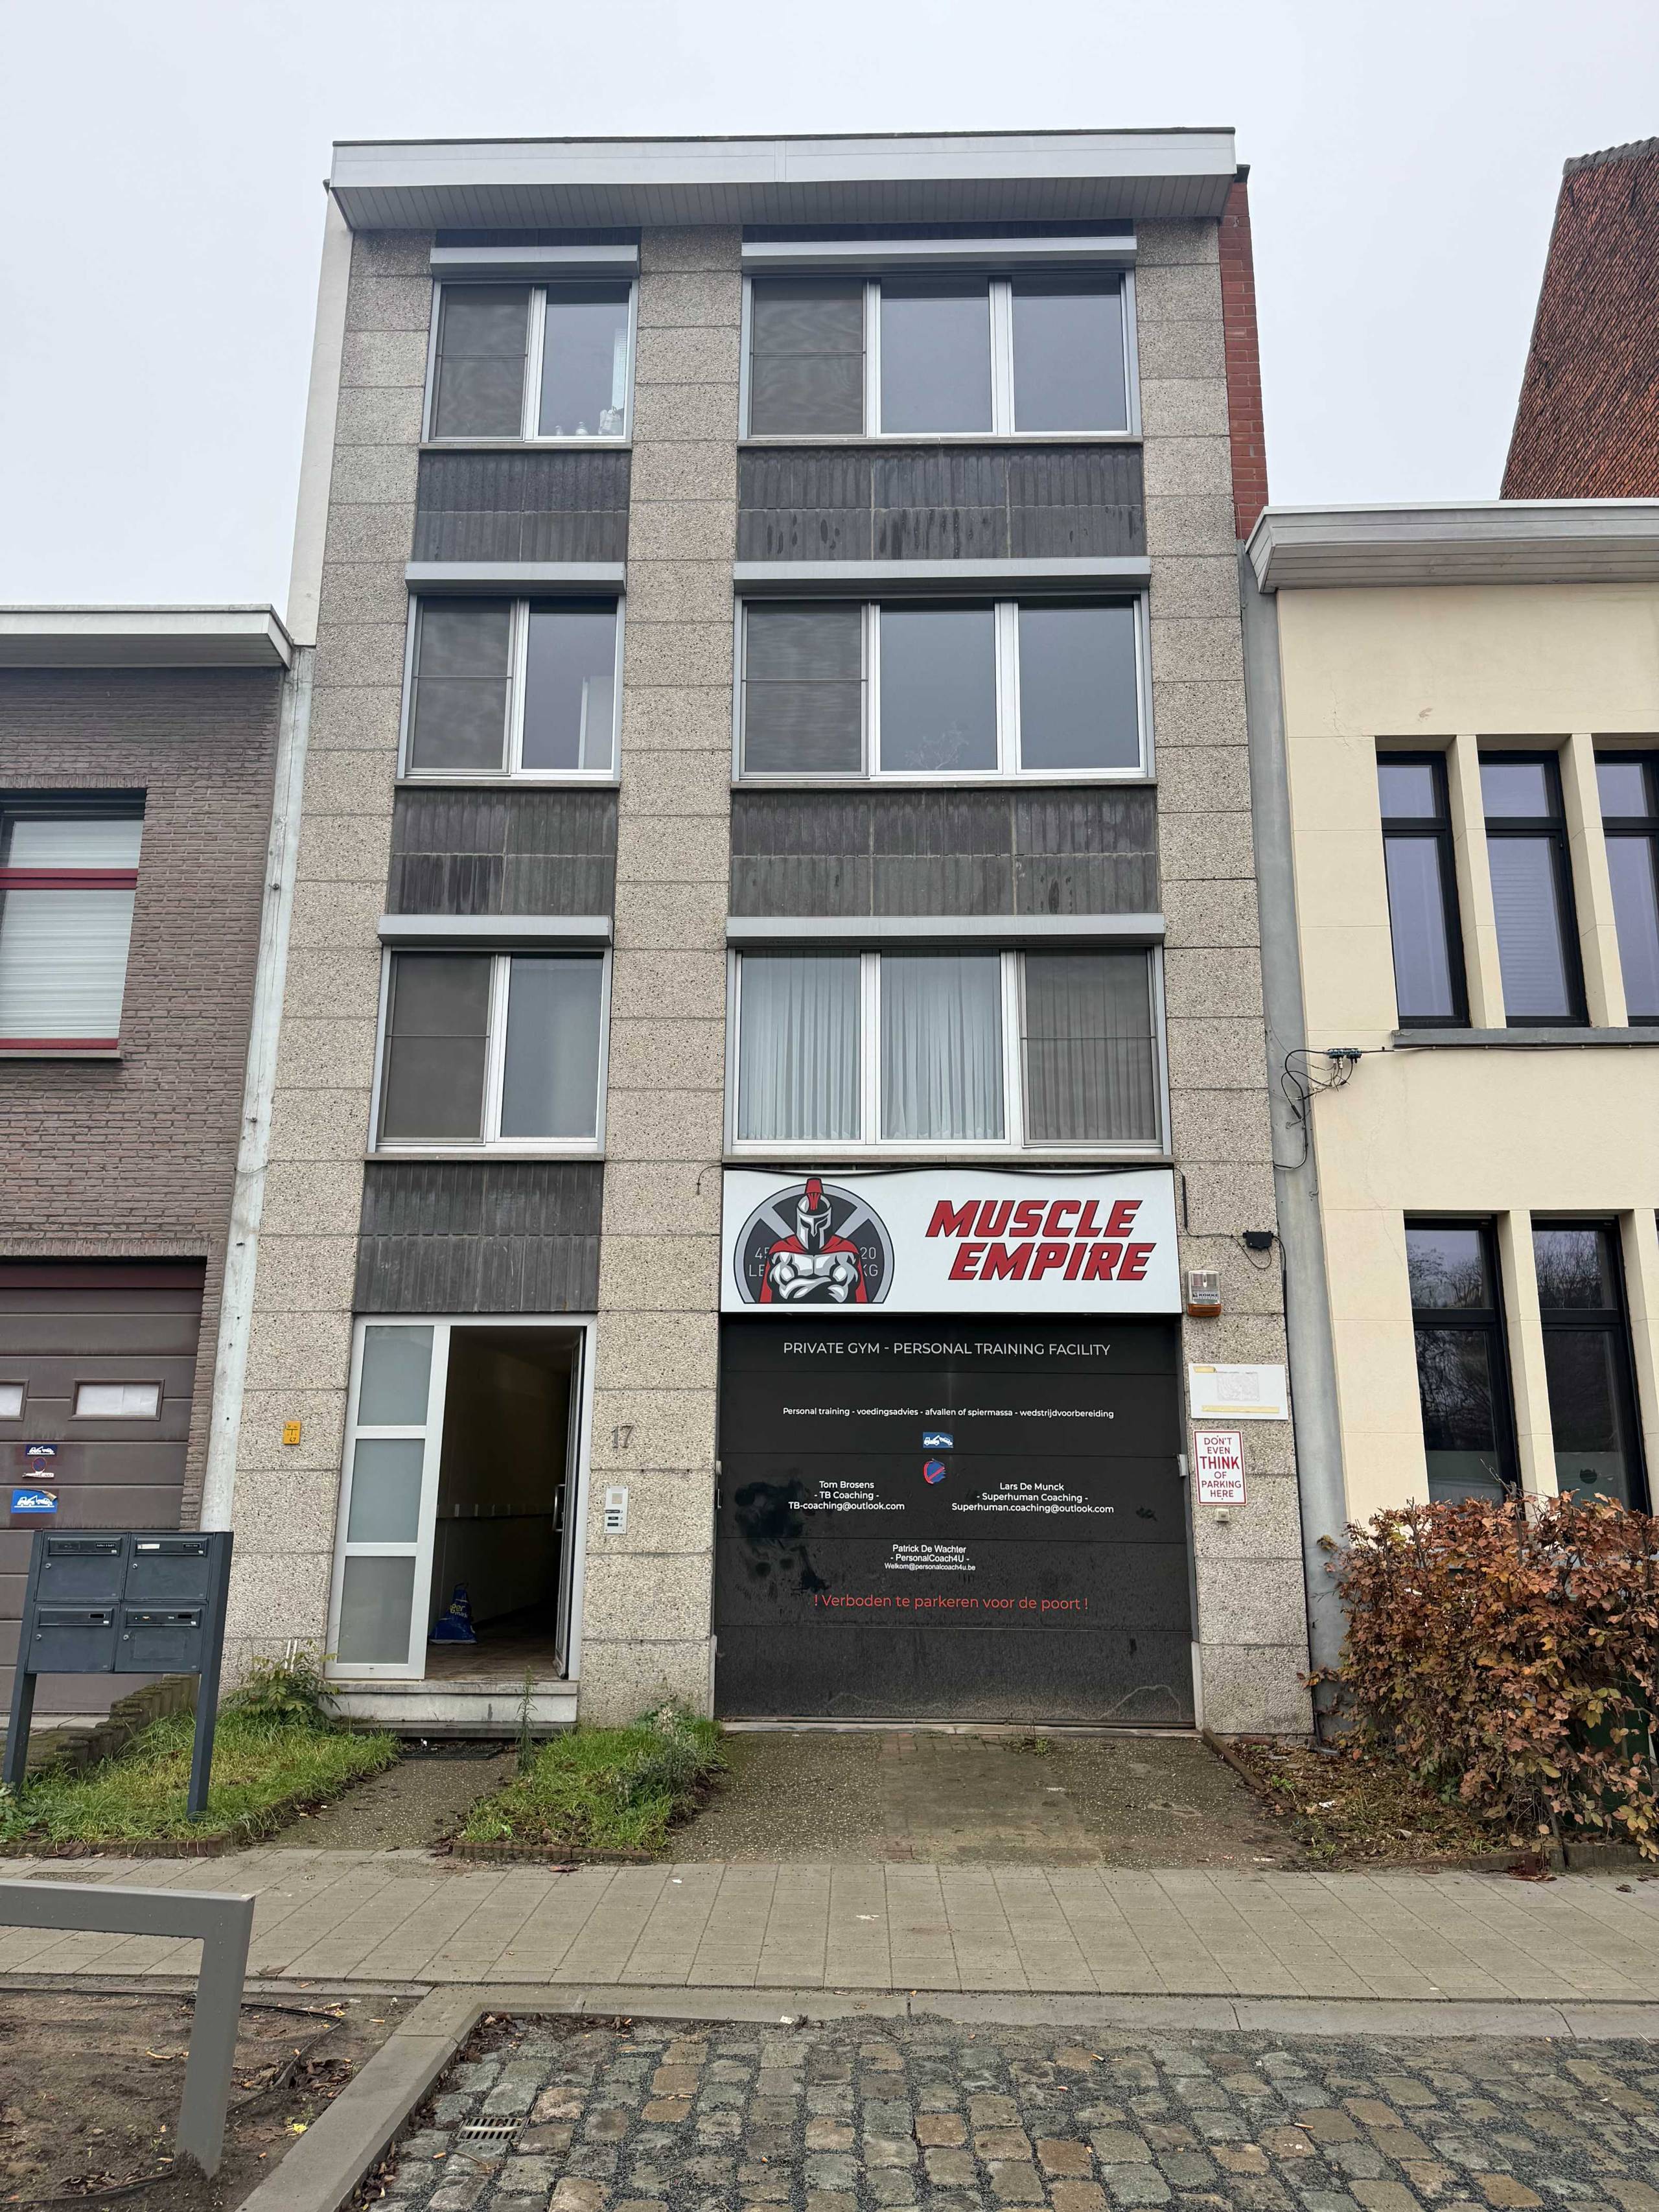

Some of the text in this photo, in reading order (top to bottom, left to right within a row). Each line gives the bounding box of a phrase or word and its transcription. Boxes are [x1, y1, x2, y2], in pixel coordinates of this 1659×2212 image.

[925, 1200, 1143, 1238] MUSCLE
[860, 1246, 876, 1260] 20
[948, 1242, 1157, 1281] EMPIRE
[783, 1342, 844, 1355] PRIVATE
[848, 1342, 880, 1355] GYM
[894, 1342, 972, 1355] PERSONAL
[975, 1343, 1045, 1355] TRAINING
[1049, 1344, 1111, 1356] FACILITY
[783, 1407, 817, 1415] Personal
[818, 1407, 850, 1417] training
[857, 1408, 919, 1417] voedingsadvies
[925, 1408, 957, 1416] afvallen
[968, 1408, 1013, 1417] spiermassa
[1019, 1409, 1115, 1419] wedstrijdvoorbereiding
[611, 1423, 634, 1448] 17
[1203, 1437, 1232, 1445] DON'T
[1207, 1446, 1231, 1454] EVEN
[1199, 1456, 1240, 1470] THINK
[819, 1480, 875, 1489] Tom Brosens
[1000, 1482, 1064, 1491] Lars De Munck
[1201, 1480, 1242, 1489] PARKING
[819, 1491, 831, 1499] TB
[833, 1491, 874, 1501] Coaching
[982, 1493, 1039, 1502] Superhuman
[1041, 1493, 1083, 1504] Coaching
[1210, 1489, 1235, 1498] HERE
[788, 1501, 905, 1511] TB-coaching@outlook.com
[951, 1502, 1114, 1514] Superhuman.coaching@outlook.com
[892, 1544, 967, 1554] Patrick De Wachter
[896, 1554, 964, 1563] PersonalCoach4U
[884, 1563, 976, 1571] Welkom@personalcoach4u.be
[821, 1594, 892, 1607] Verboden
[896, 1596, 910, 1607] te
[914, 1595, 979, 1610] parkeren
[982, 1598, 1014, 1609] voor
[1018, 1597, 1037, 1609] de
[1041, 1598, 1081, 1612] poort
